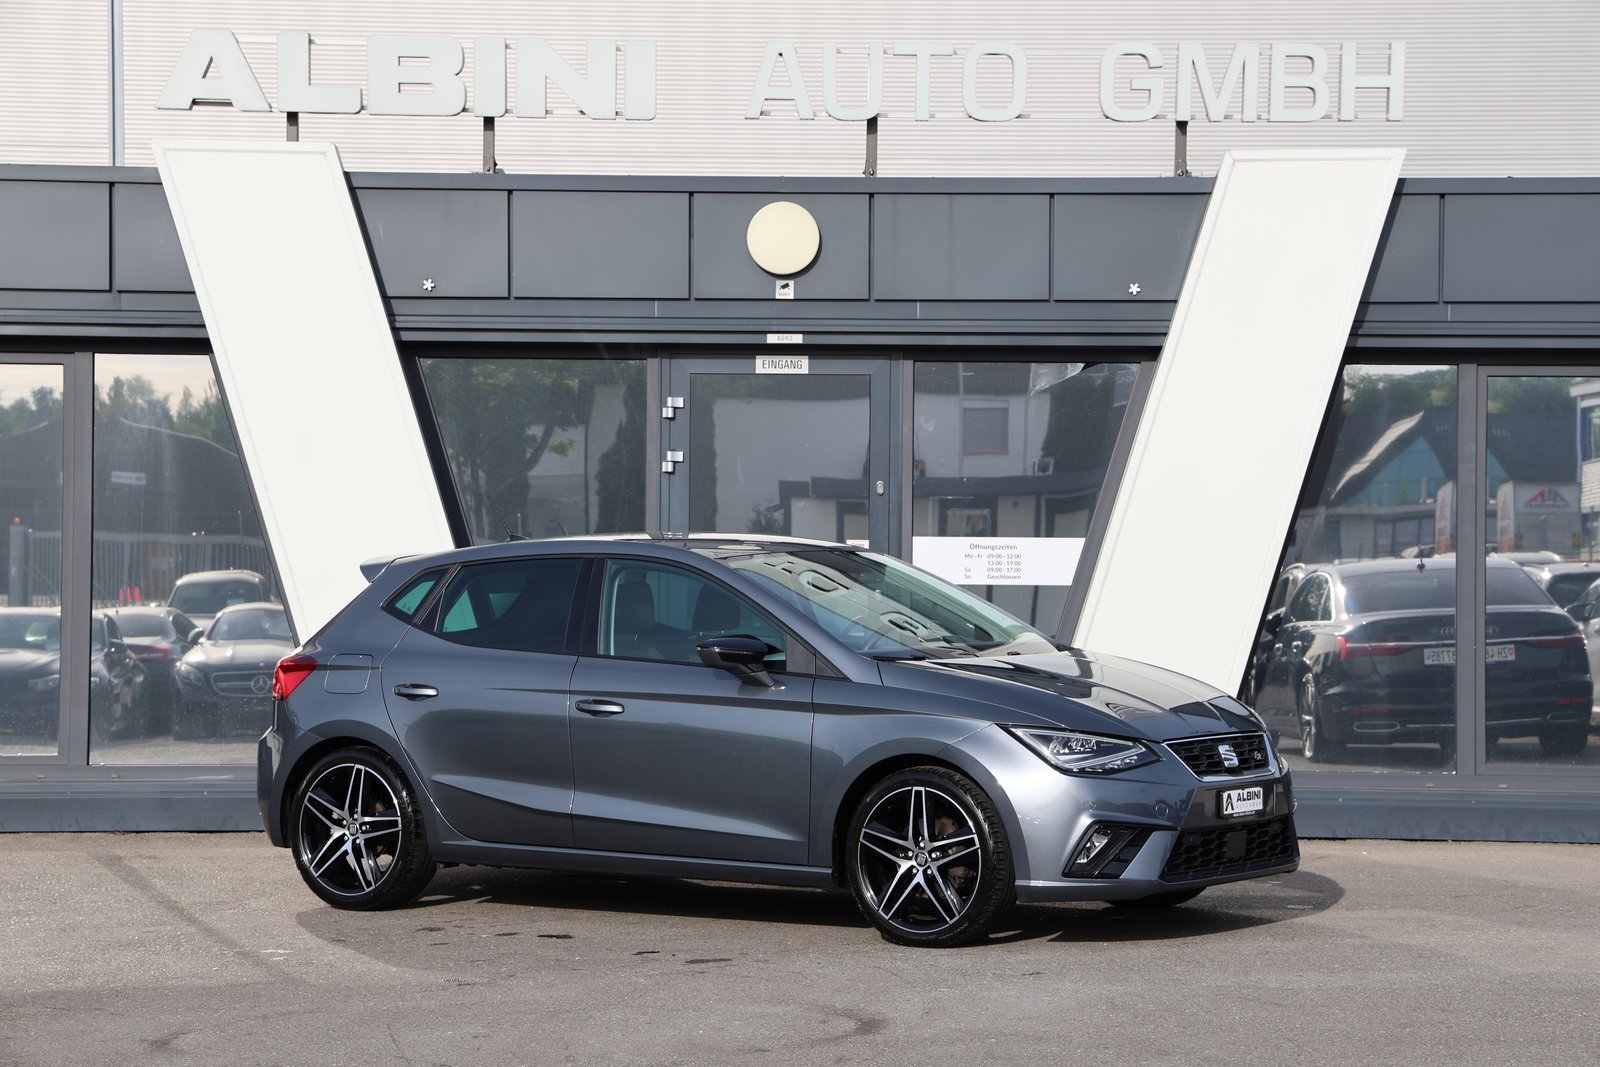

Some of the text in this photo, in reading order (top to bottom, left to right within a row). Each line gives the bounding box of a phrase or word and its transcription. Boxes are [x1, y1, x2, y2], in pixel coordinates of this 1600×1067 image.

[157, 29, 1406, 122] ALBINI AUTO GMBH
[762, 359, 803, 370] EINGANG
[969, 543, 1018, 551] Öffnungszeiten
[1236, 789, 1261, 803] ALBINI
